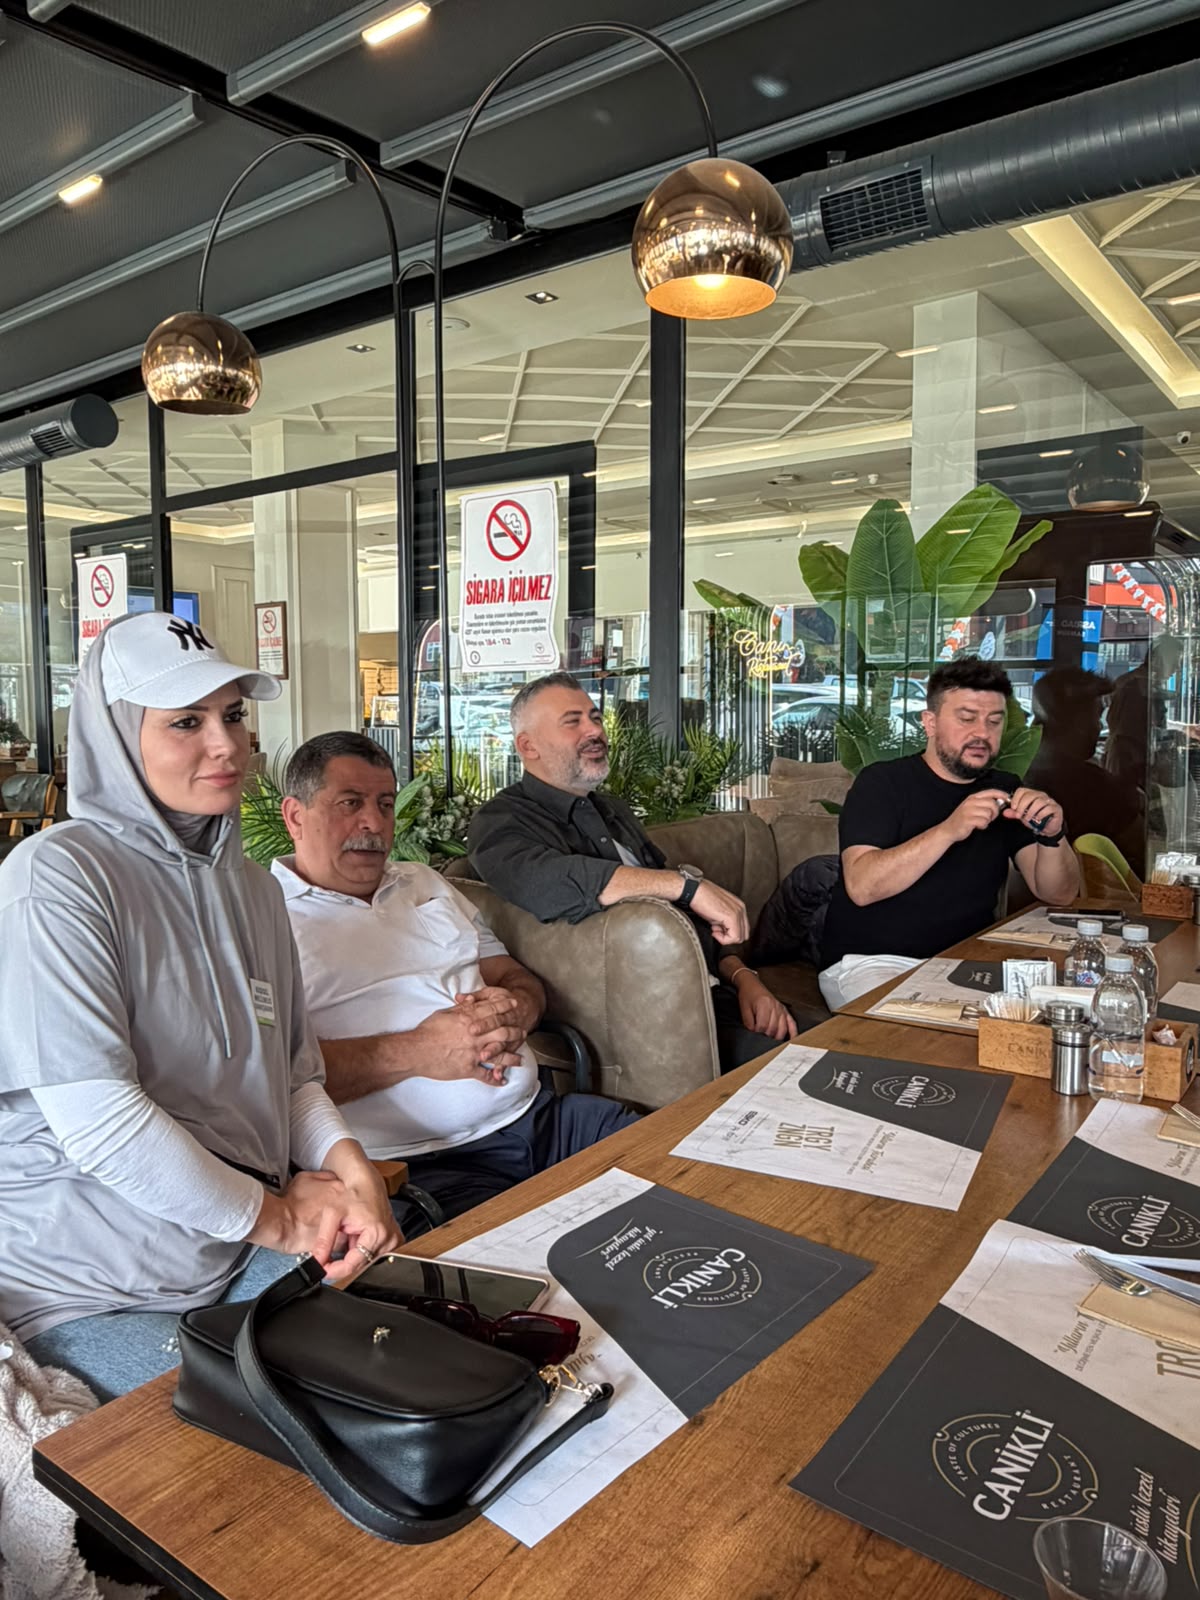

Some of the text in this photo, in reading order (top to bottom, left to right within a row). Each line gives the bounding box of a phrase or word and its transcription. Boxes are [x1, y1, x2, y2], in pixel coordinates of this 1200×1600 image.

[466, 570, 552, 606] SİGARA İÇİLMEZ
[894, 1075, 930, 1109] CANİKLİ
[803, 1125, 835, 1152] TRGY
[1121, 1195, 1171, 1248] CANİKLİ
[651, 1248, 746, 1310] CANİKLİ
[948, 1423, 1000, 1482] TASTE OF CULTURES
[972, 1409, 1055, 1521] CANİKLİ
[1041, 1455, 1082, 1510] RESTAURANT
